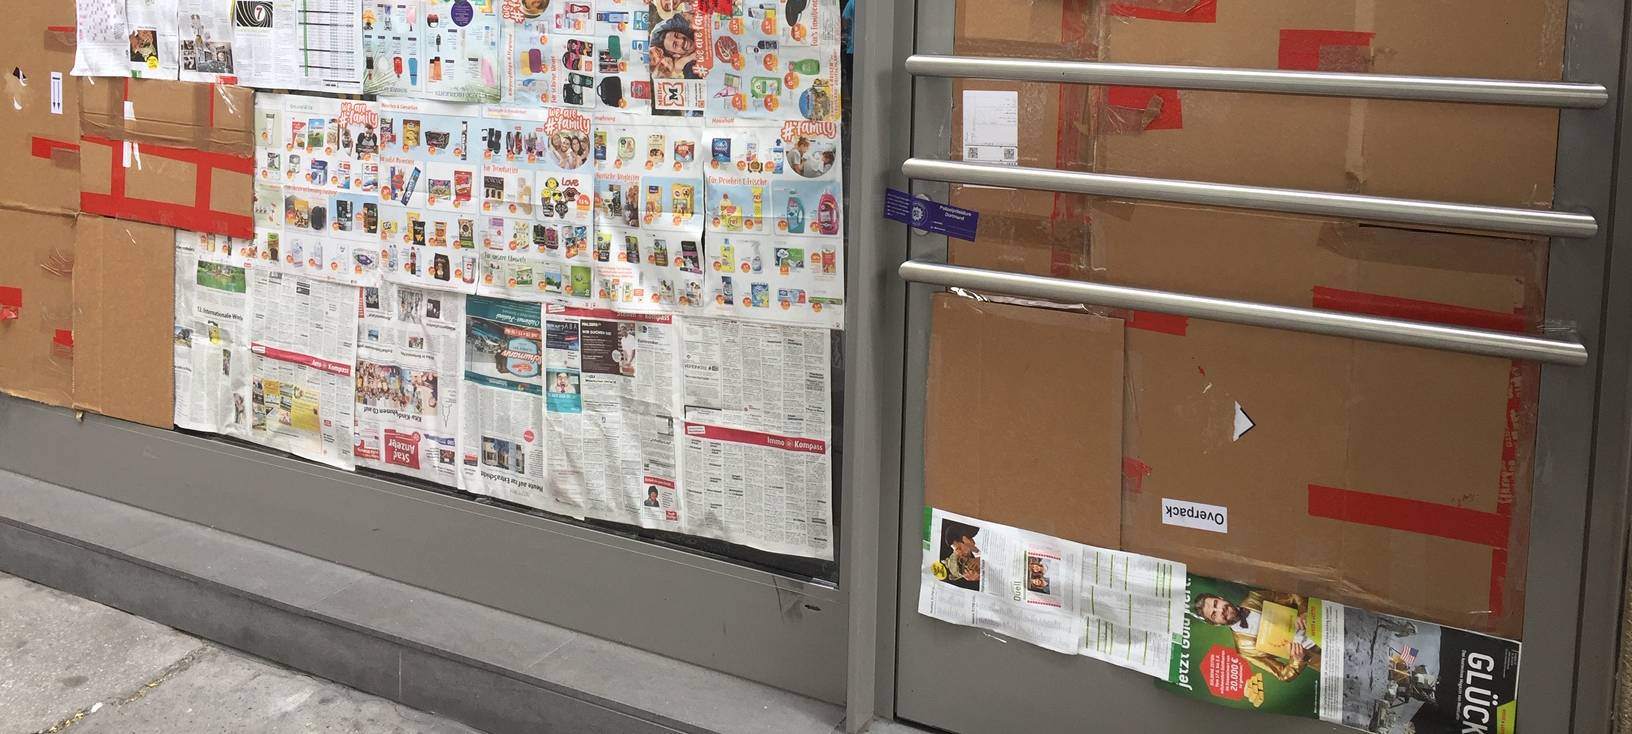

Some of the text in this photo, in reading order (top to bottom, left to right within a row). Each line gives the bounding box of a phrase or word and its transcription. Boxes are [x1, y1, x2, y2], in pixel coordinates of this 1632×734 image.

[254, 6, 264, 21] 7
[695, 31, 704, 49] are
[341, 102, 368, 113] we are
[549, 107, 579, 120] we are
[338, 110, 379, 129] #family
[543, 115, 591, 136] #family
[561, 176, 580, 187] Love
[767, 436, 823, 452] Immo Kompass
[1165, 505, 1225, 526] Overpack
[1012, 580, 1022, 602] Duell
[1230, 664, 1239, 692] 20.000
